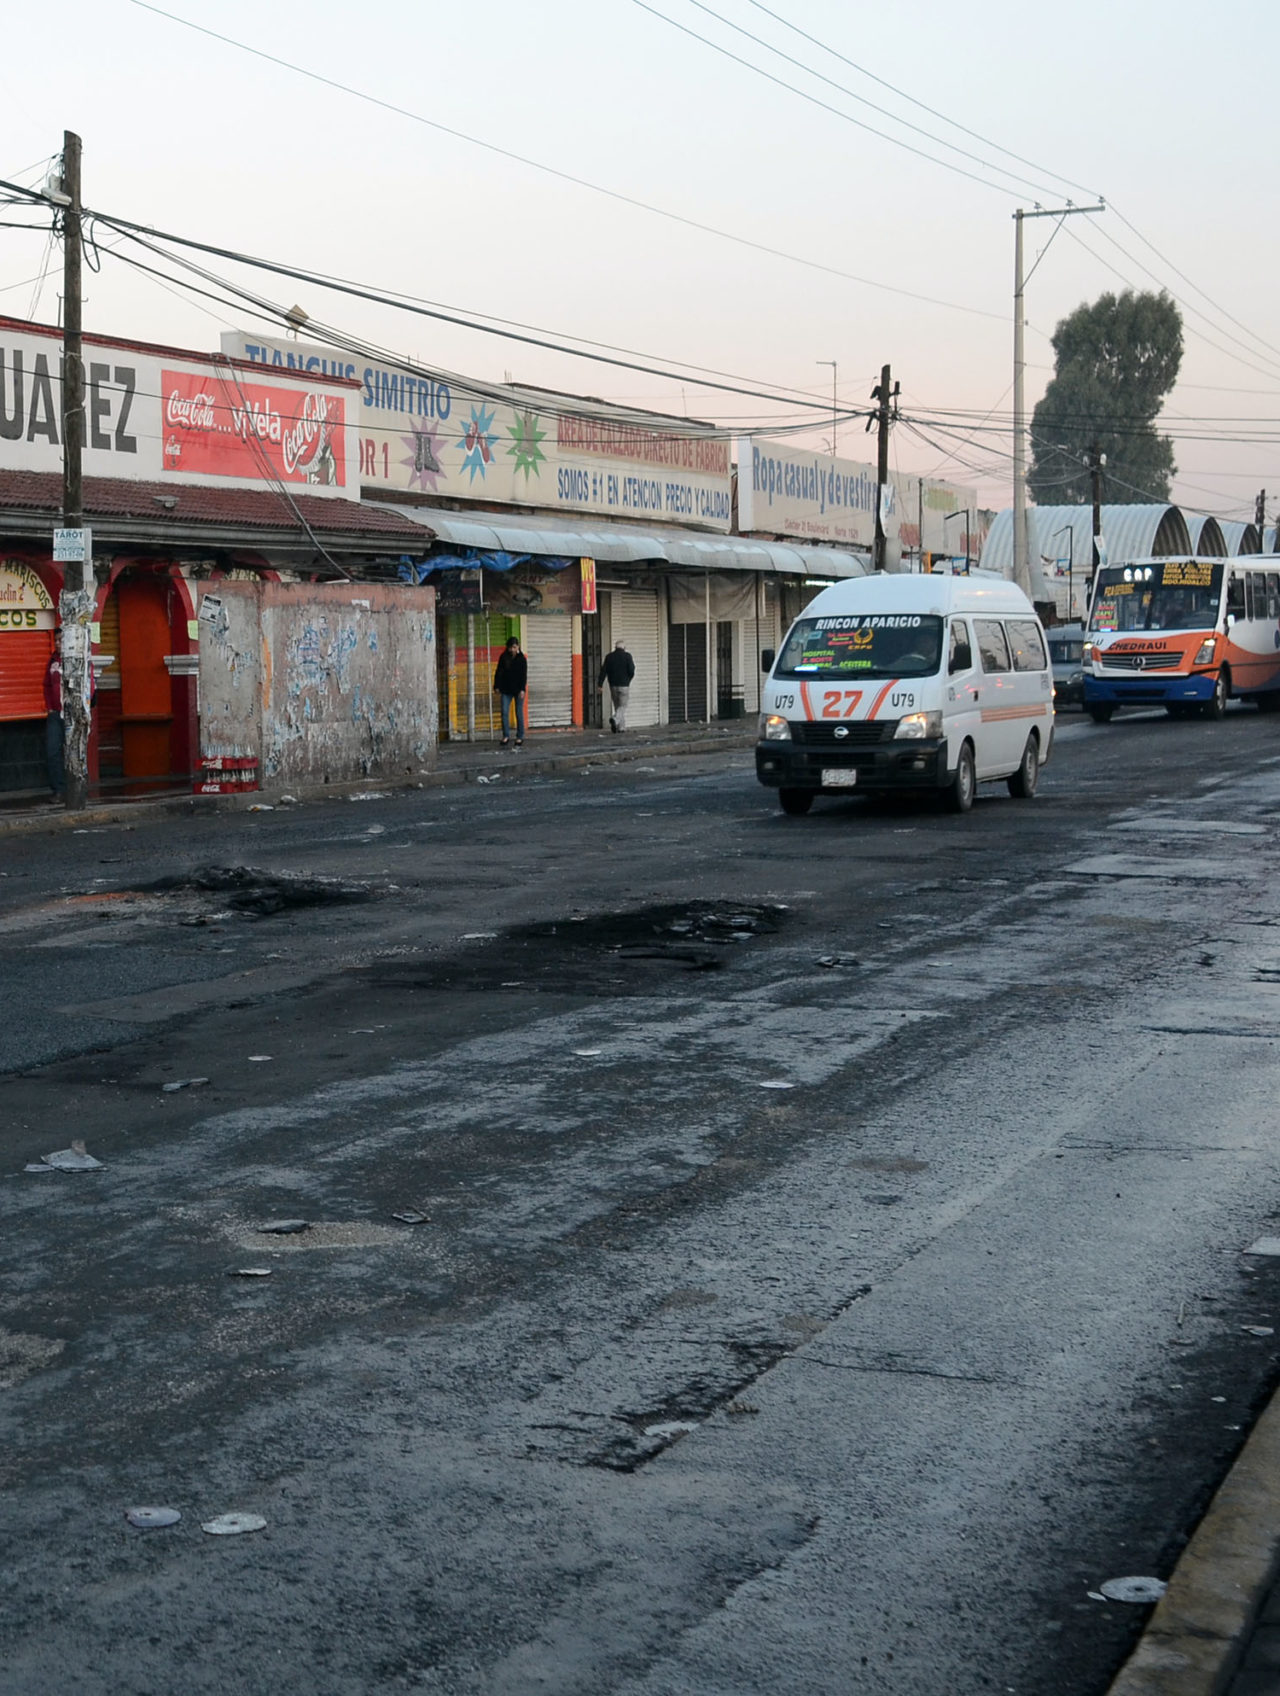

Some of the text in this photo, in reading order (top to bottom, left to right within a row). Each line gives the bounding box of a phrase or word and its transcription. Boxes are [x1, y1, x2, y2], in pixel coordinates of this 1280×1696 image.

[363, 367, 451, 420] SIMITRIO
[752, 446, 783, 507] Ropa
[784, 459, 819, 502] casual
[828, 464, 841, 506] de
[558, 467, 589, 502] SOMOS
[607, 474, 619, 506] EN
[622, 476, 662, 511] ATENCION
[665, 483, 692, 515] PRECIO
[55, 530, 84, 539] TAROT
[815, 616, 922, 630] RINCON APARICIO
[1108, 641, 1167, 650] CHEDRAUI
[774, 694, 795, 709] U79
[822, 690, 863, 718] 27
[891, 693, 915, 707] U79
